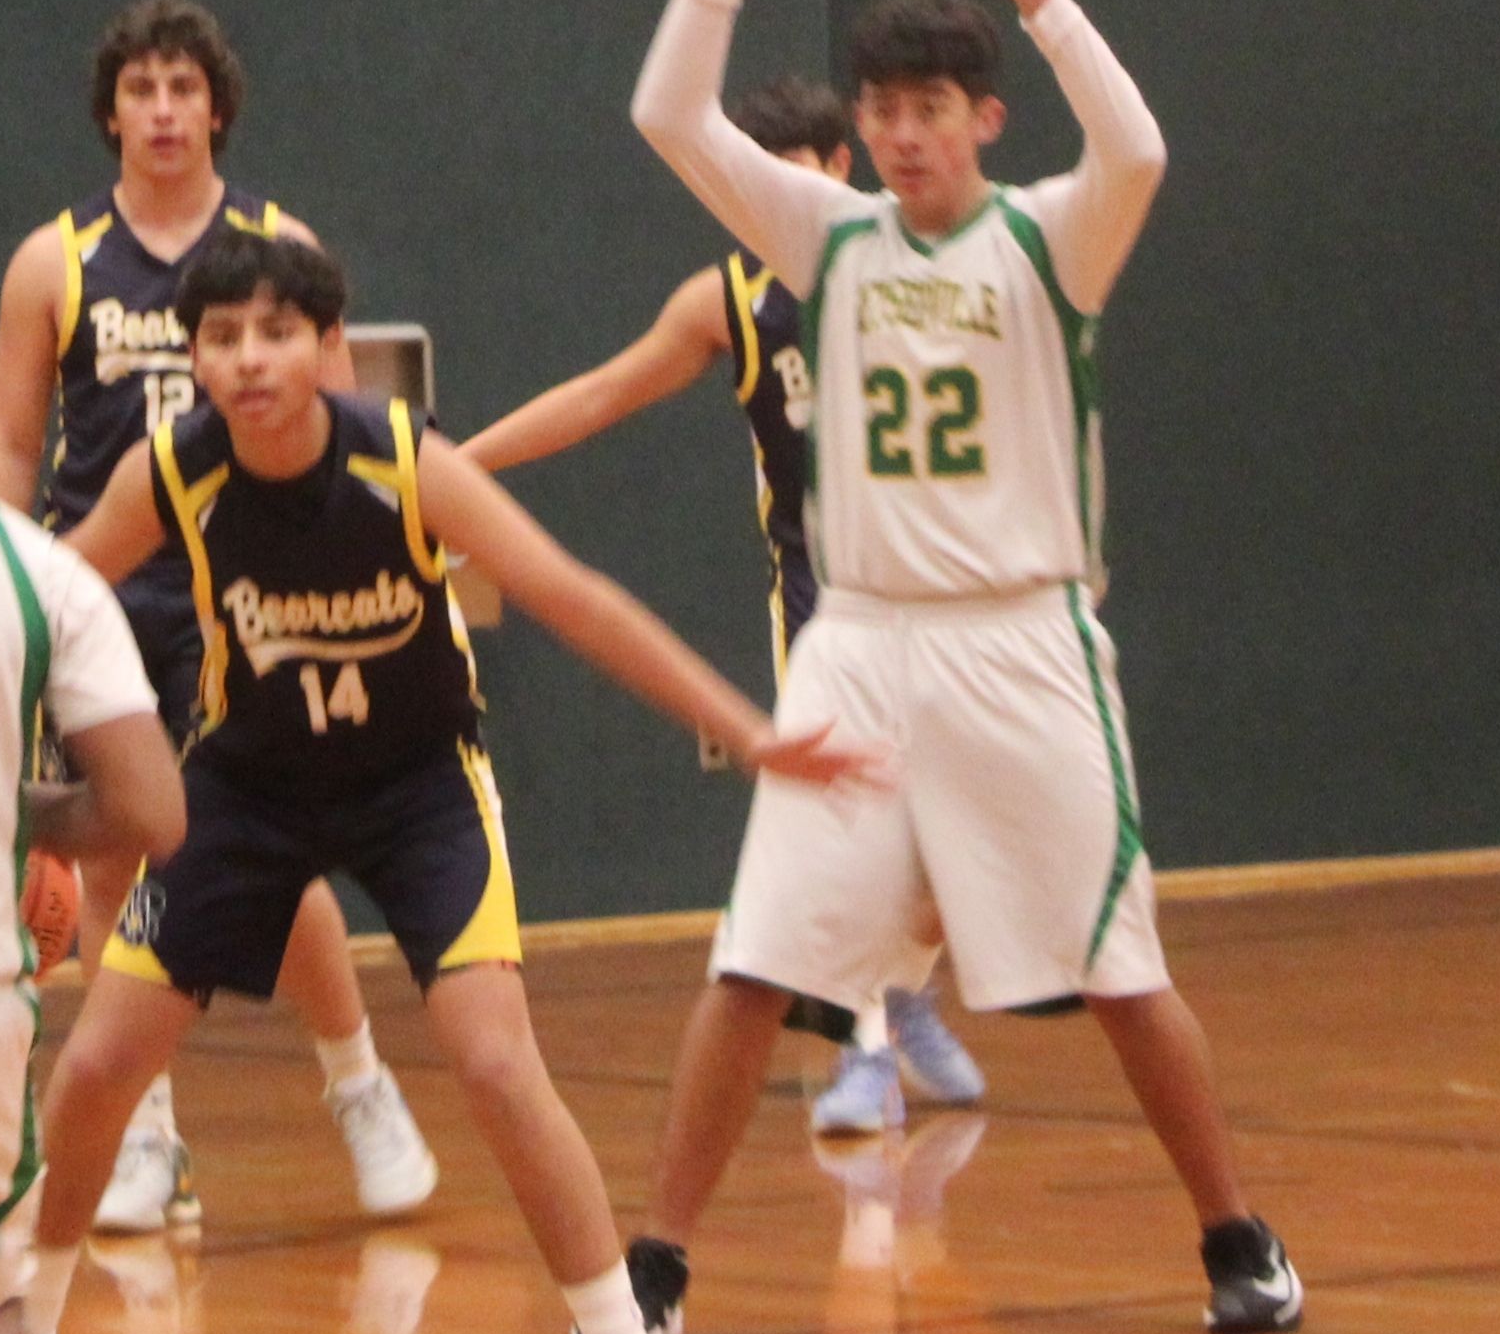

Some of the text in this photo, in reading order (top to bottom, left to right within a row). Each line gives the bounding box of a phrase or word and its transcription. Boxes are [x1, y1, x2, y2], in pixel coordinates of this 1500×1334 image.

[861, 364, 988, 481] 22
[222, 568, 424, 665] Bearcats
[300, 662, 370, 736] 14
